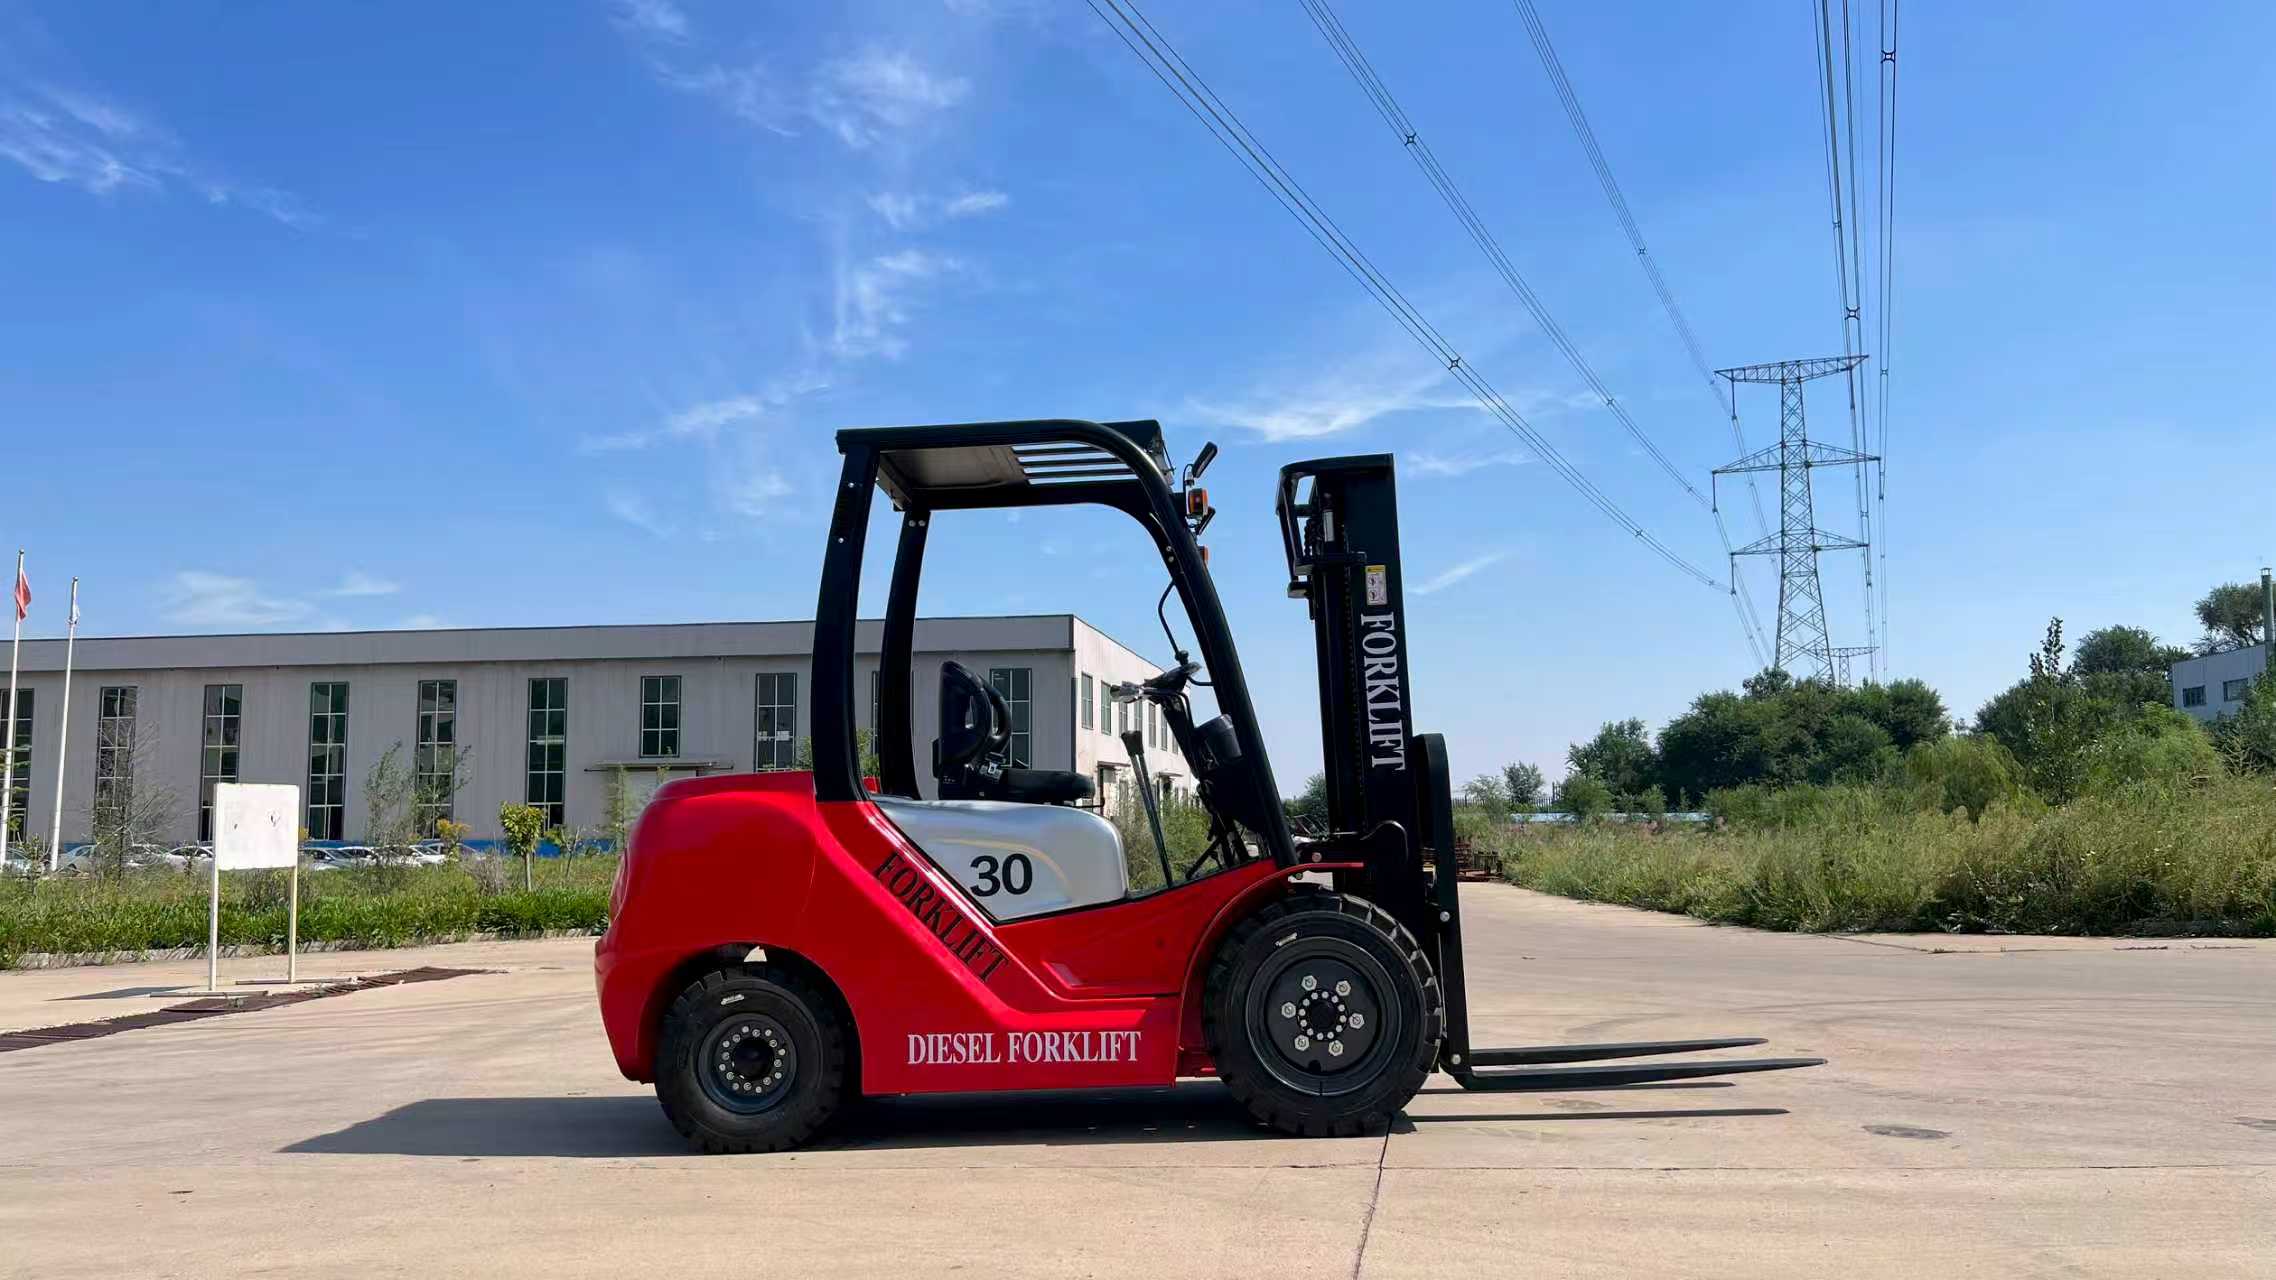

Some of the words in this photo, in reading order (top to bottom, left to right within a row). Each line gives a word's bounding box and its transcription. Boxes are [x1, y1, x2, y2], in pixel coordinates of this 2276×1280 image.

[1361, 612, 1406, 771] FORKLIFT
[874, 851, 1009, 983] FORKLIFT
[969, 853, 1033, 896] 30
[907, 1033, 1001, 1064] DIESEL
[1007, 1031, 1142, 1063] FORKLIFT
